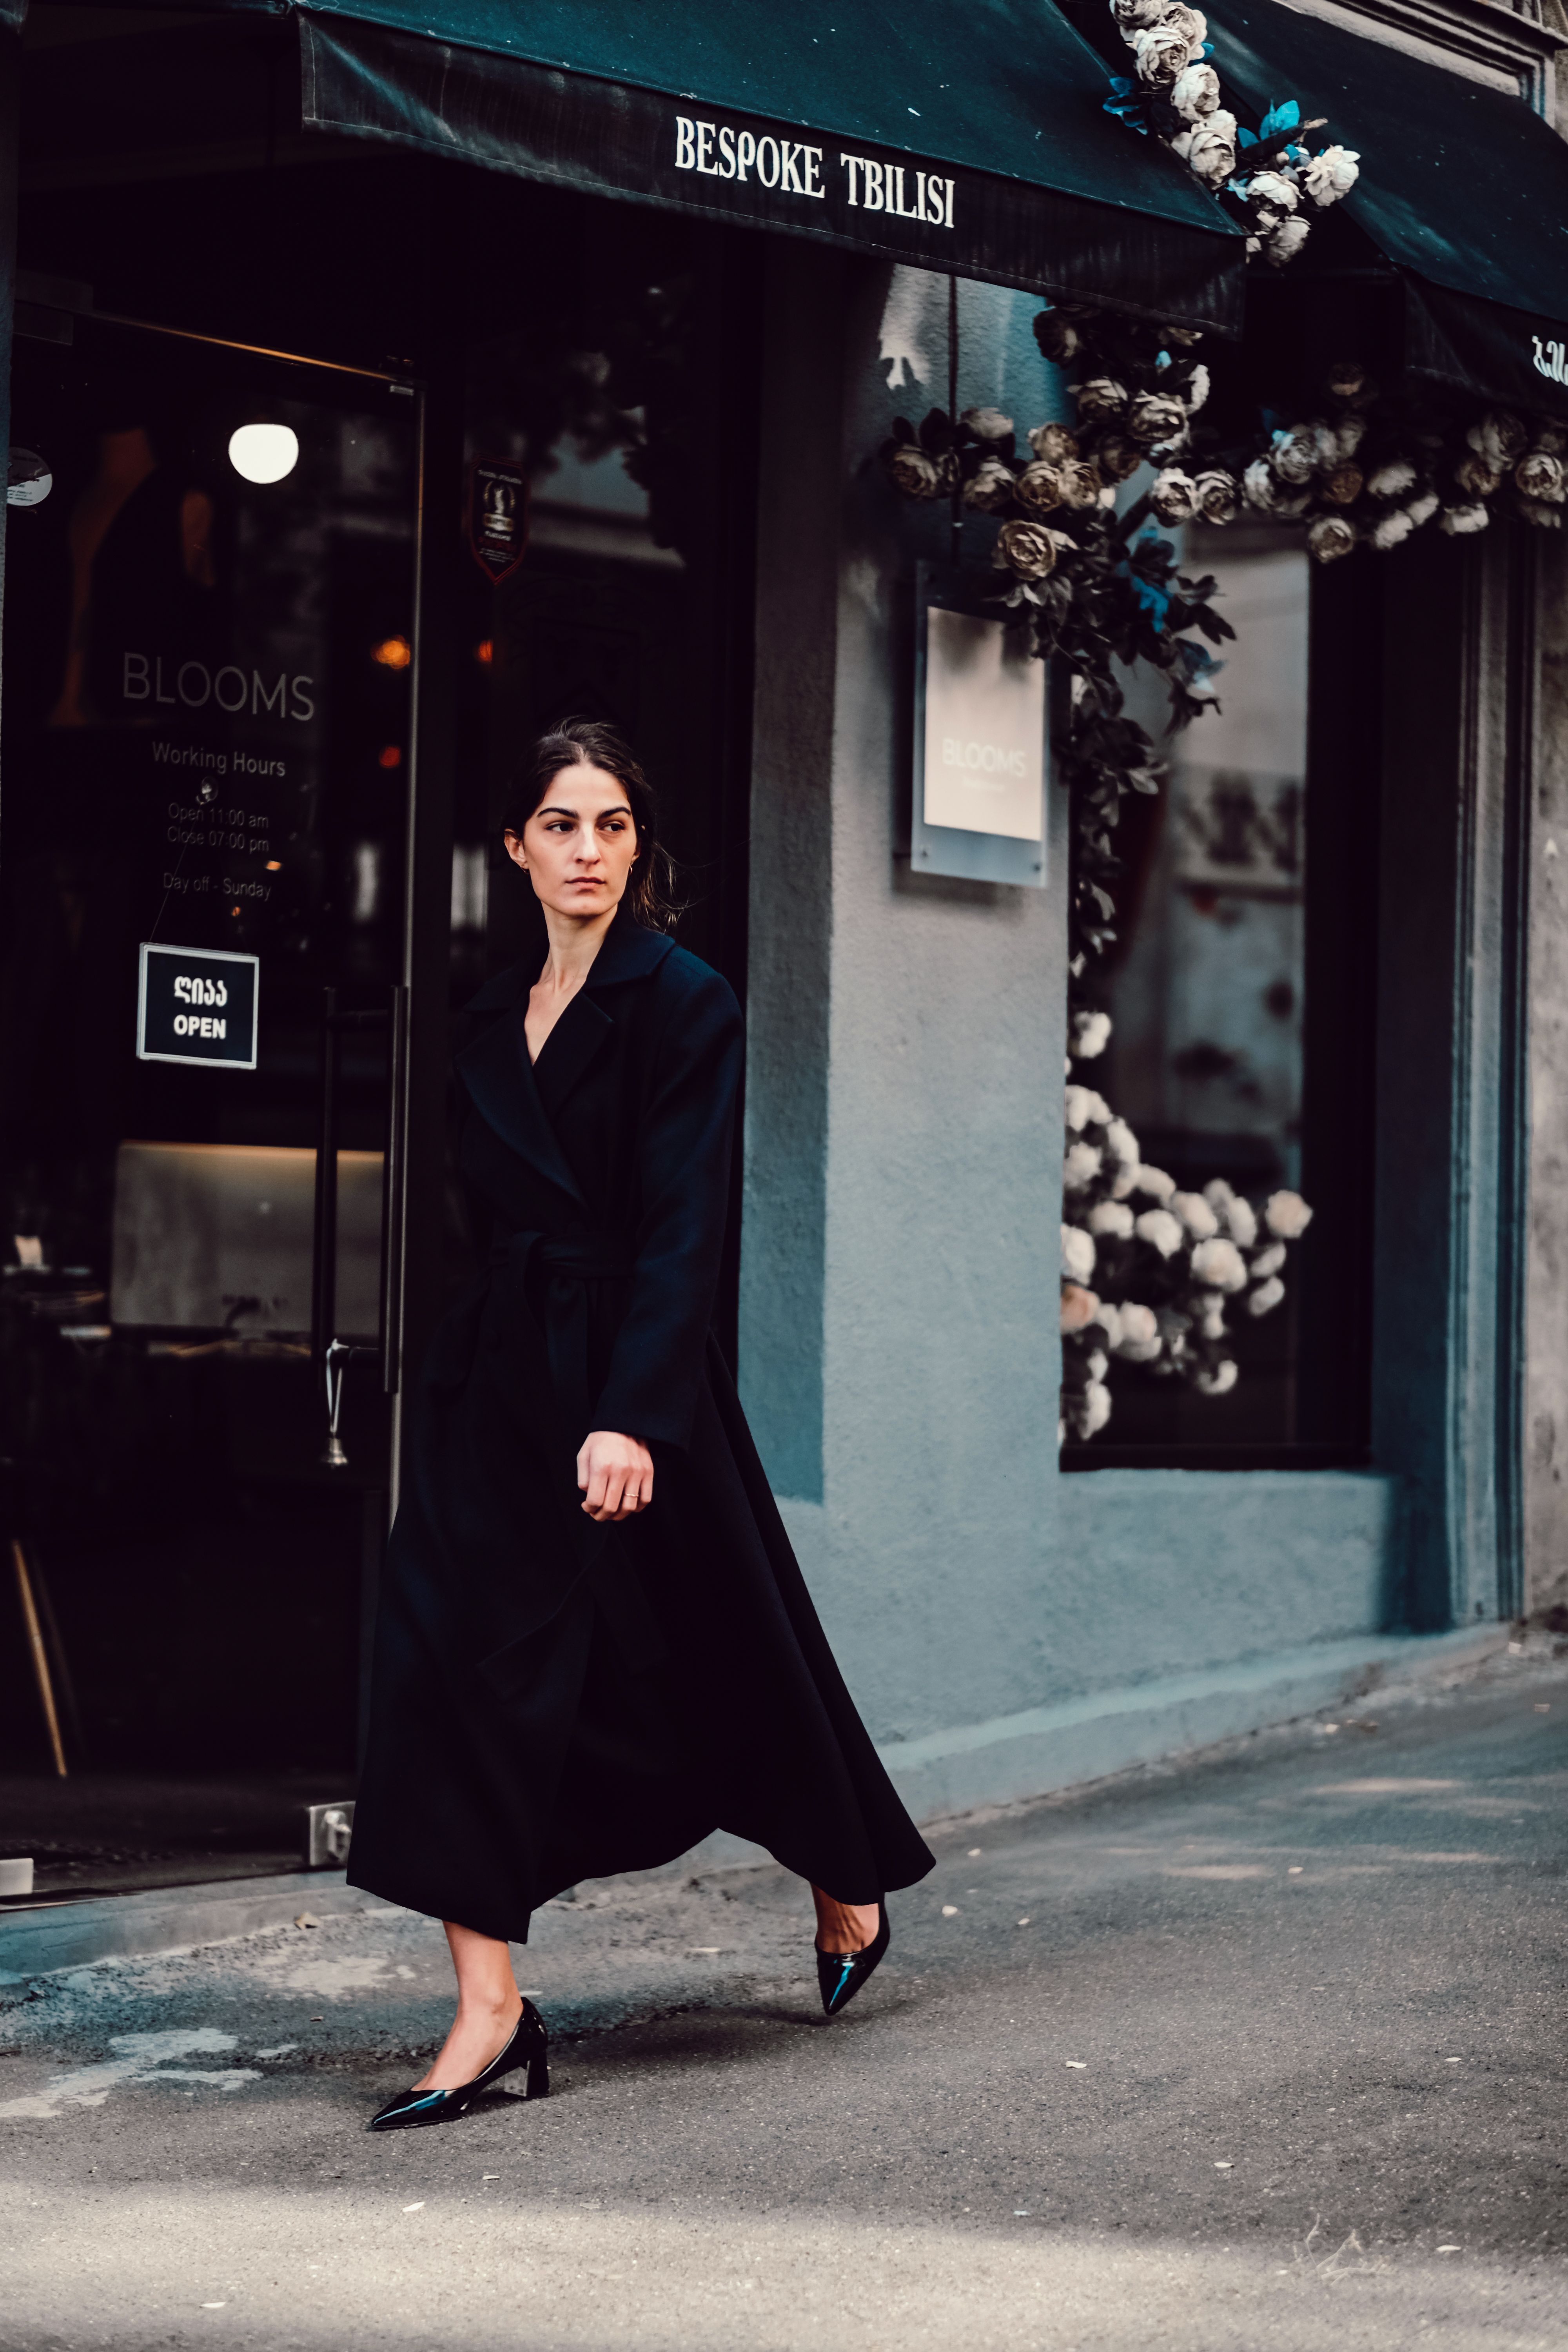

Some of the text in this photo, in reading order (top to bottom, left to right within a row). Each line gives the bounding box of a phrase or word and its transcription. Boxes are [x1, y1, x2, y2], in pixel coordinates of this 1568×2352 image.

[675, 116, 955, 228] BESPOKE TBILISI
[123, 652, 314, 721] BLOOMS
[152, 740, 286, 777] Working Hours
[942, 737, 1027, 777] BLOOMS
[168, 802, 269, 829] Open 11:00 am
[167, 826, 270, 855] Close 07:00 pm
[163, 872, 189, 895] Day
[193, 875, 211, 892] off
[222, 877, 272, 902] Sunday
[174, 976, 227, 1007] ღიაა
[174, 1014, 227, 1040] OPEN
